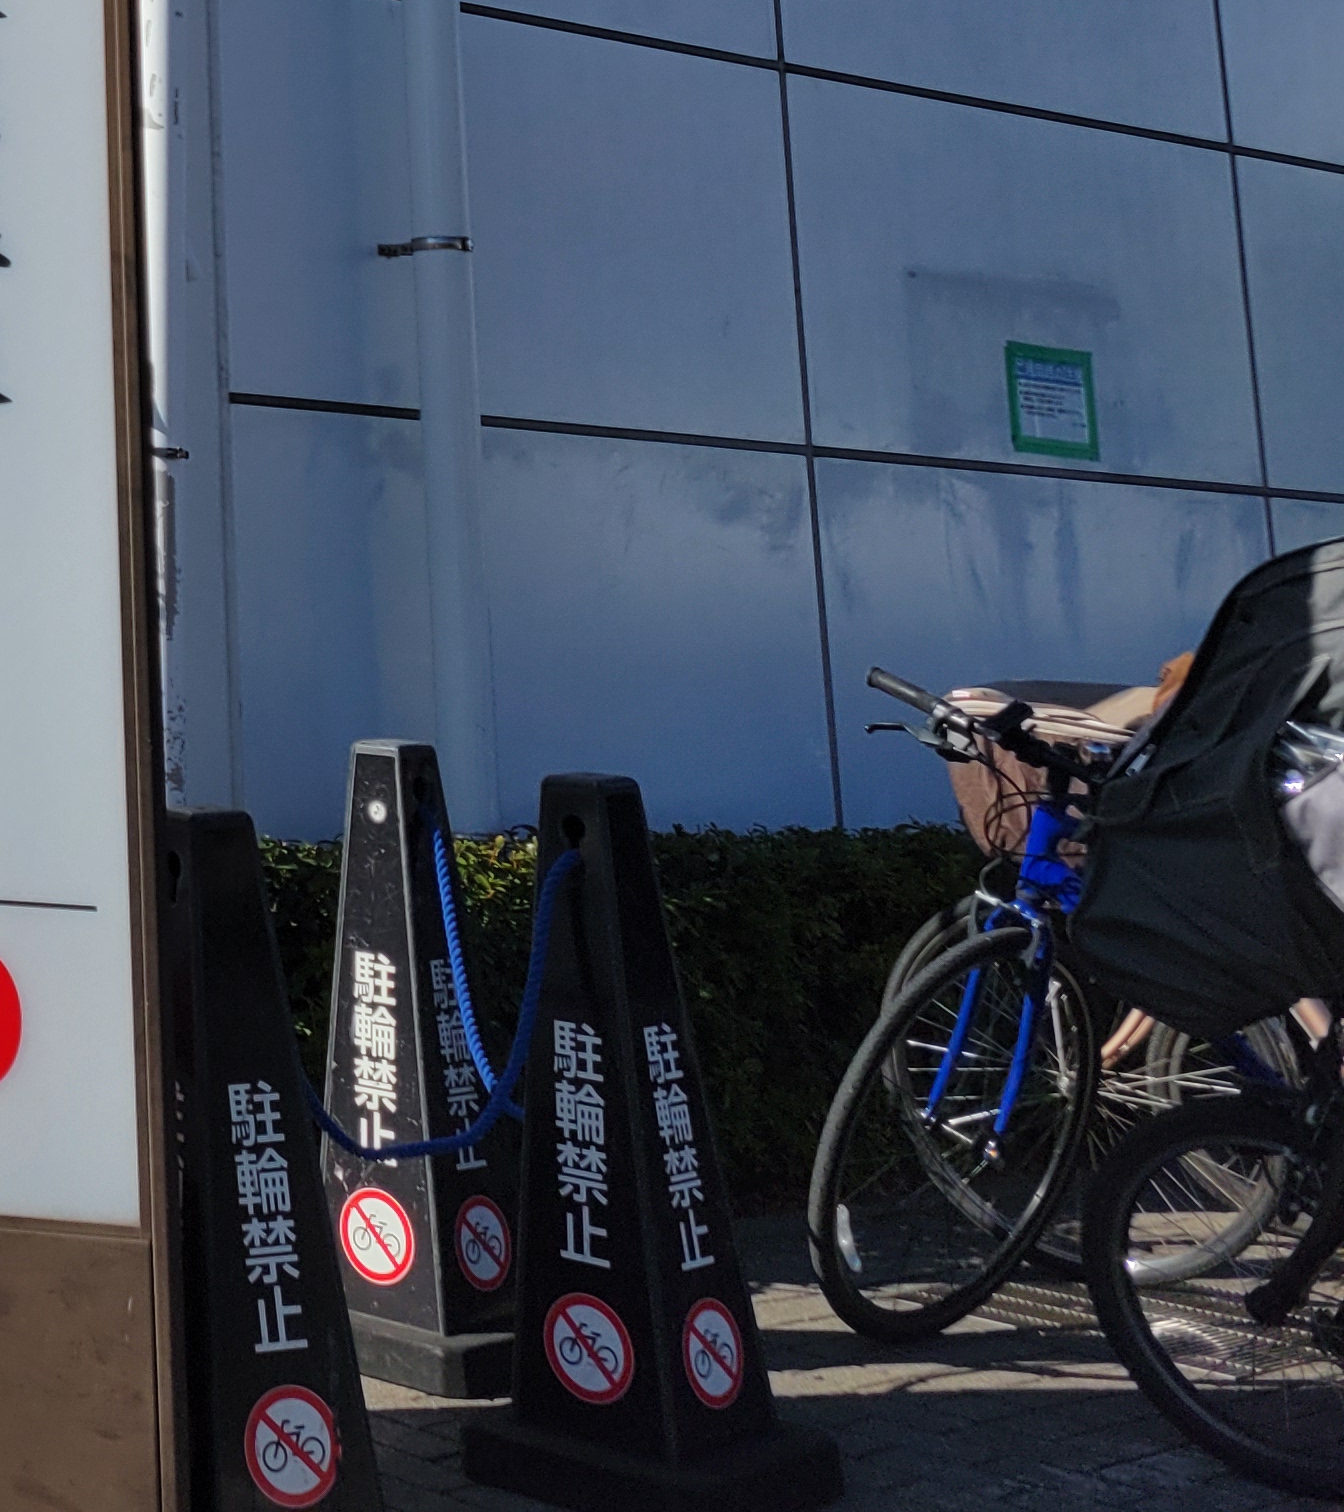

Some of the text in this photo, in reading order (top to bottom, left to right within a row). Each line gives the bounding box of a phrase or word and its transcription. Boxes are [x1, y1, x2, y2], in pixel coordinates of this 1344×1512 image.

[353, 950, 397, 1169] 駐輪禁止
[553, 1019, 612, 1270] 駐輪禁止
[643, 1022, 716, 1272] 駐輪禁止
[228, 1081, 310, 1355] 駐輪禁止
